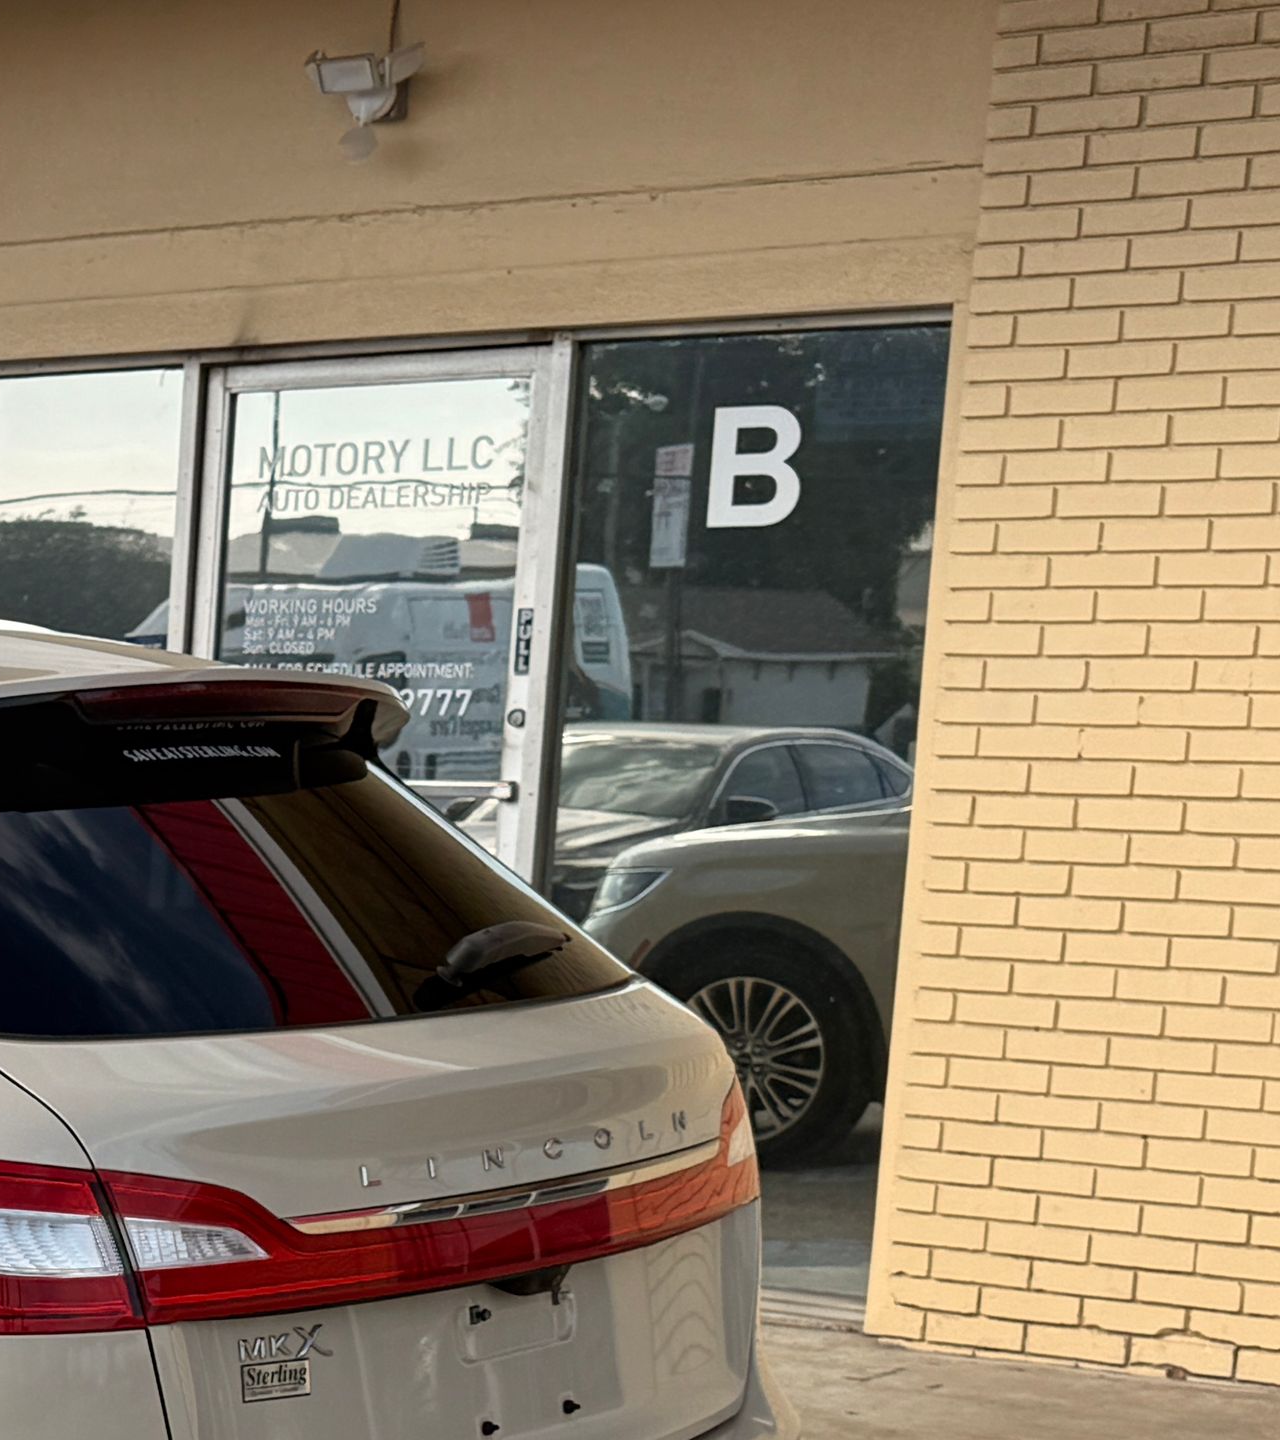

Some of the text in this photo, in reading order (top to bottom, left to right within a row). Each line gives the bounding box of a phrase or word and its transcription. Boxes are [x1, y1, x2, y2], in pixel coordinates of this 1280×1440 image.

[258, 435, 495, 479] MOTORY LLC
[706, 405, 801, 529] B
[257, 482, 491, 513] AUTO DEALERSHIP
[243, 598, 377, 614] WORKING HOURS
[301, 614, 317, 626] AM
[335, 614, 351, 626] PM
[276, 628, 295, 640] AM
[317, 627, 336, 640] PM
[517, 610, 532, 671] PULL
[269, 641, 315, 654] CLOSED
[306, 662, 376, 678] SCHEDULE
[377, 662, 475, 678] APPOINTMENT:
[359, 1110, 687, 1188] LINCOLN
[238, 1324, 333, 1361] MKX
[246, 1364, 307, 1386] Sterling
